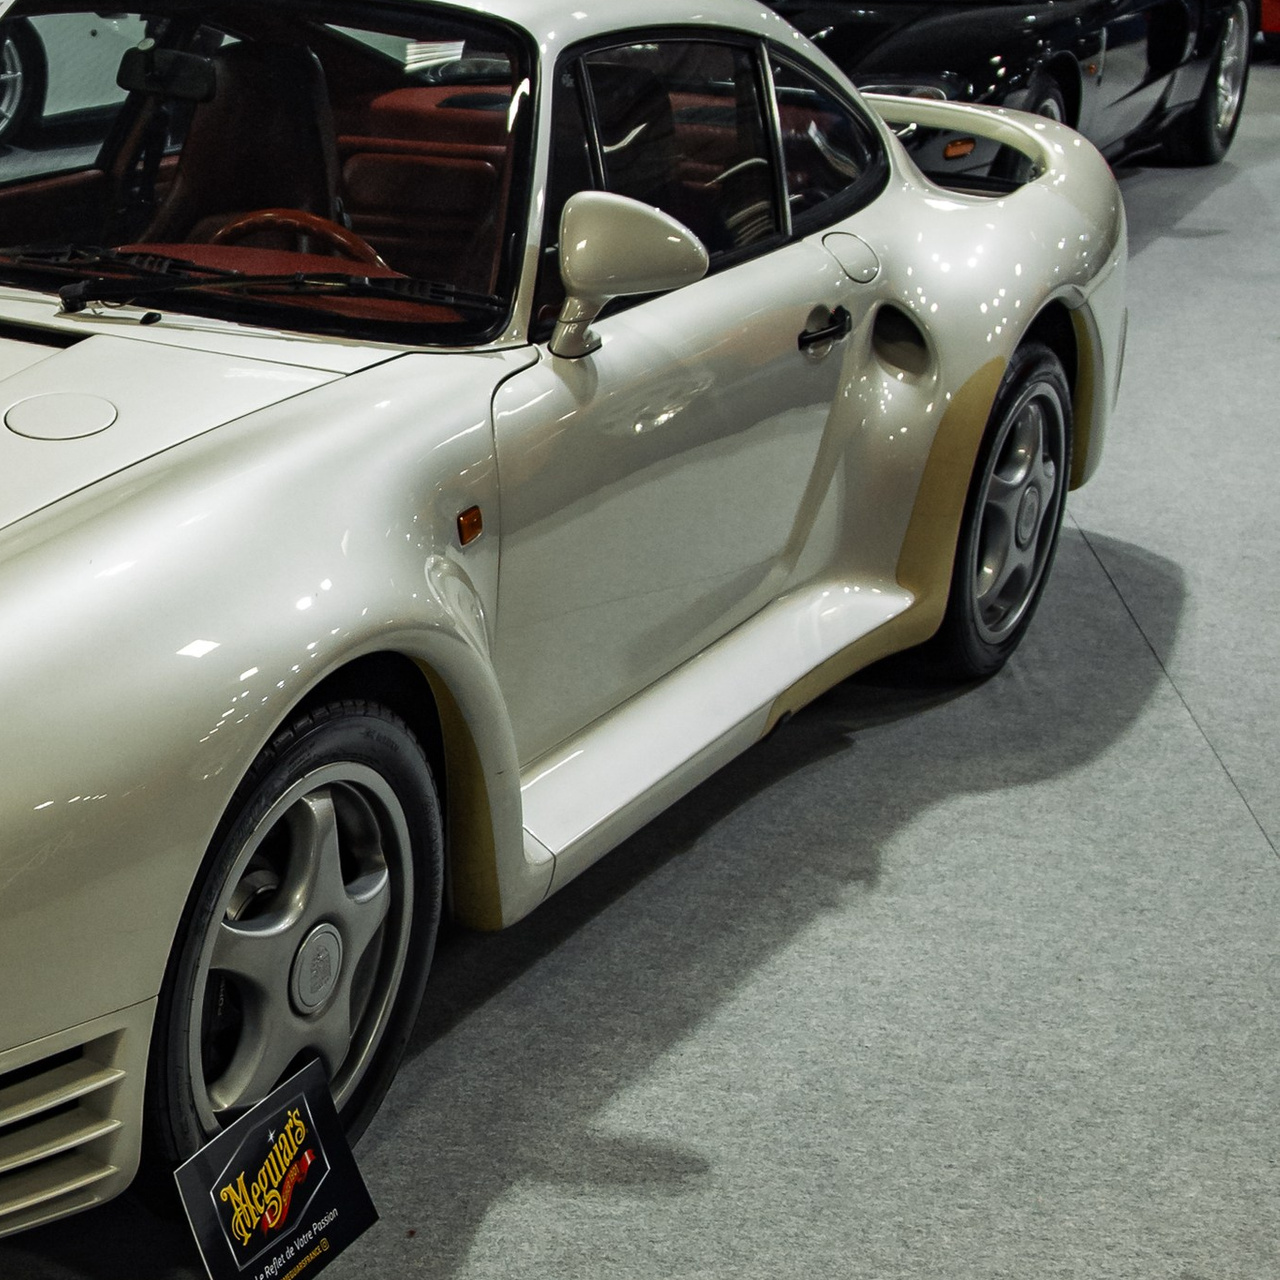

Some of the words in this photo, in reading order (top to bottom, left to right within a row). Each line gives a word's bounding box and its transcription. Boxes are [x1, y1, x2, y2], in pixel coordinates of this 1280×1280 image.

[220, 1107, 306, 1246] Meguiar's
[264, 1254, 286, 1278] Reflet
[285, 1245, 295, 1260] de
[293, 1230, 313, 1251] Votre
[312, 1208, 339, 1235] Passion
